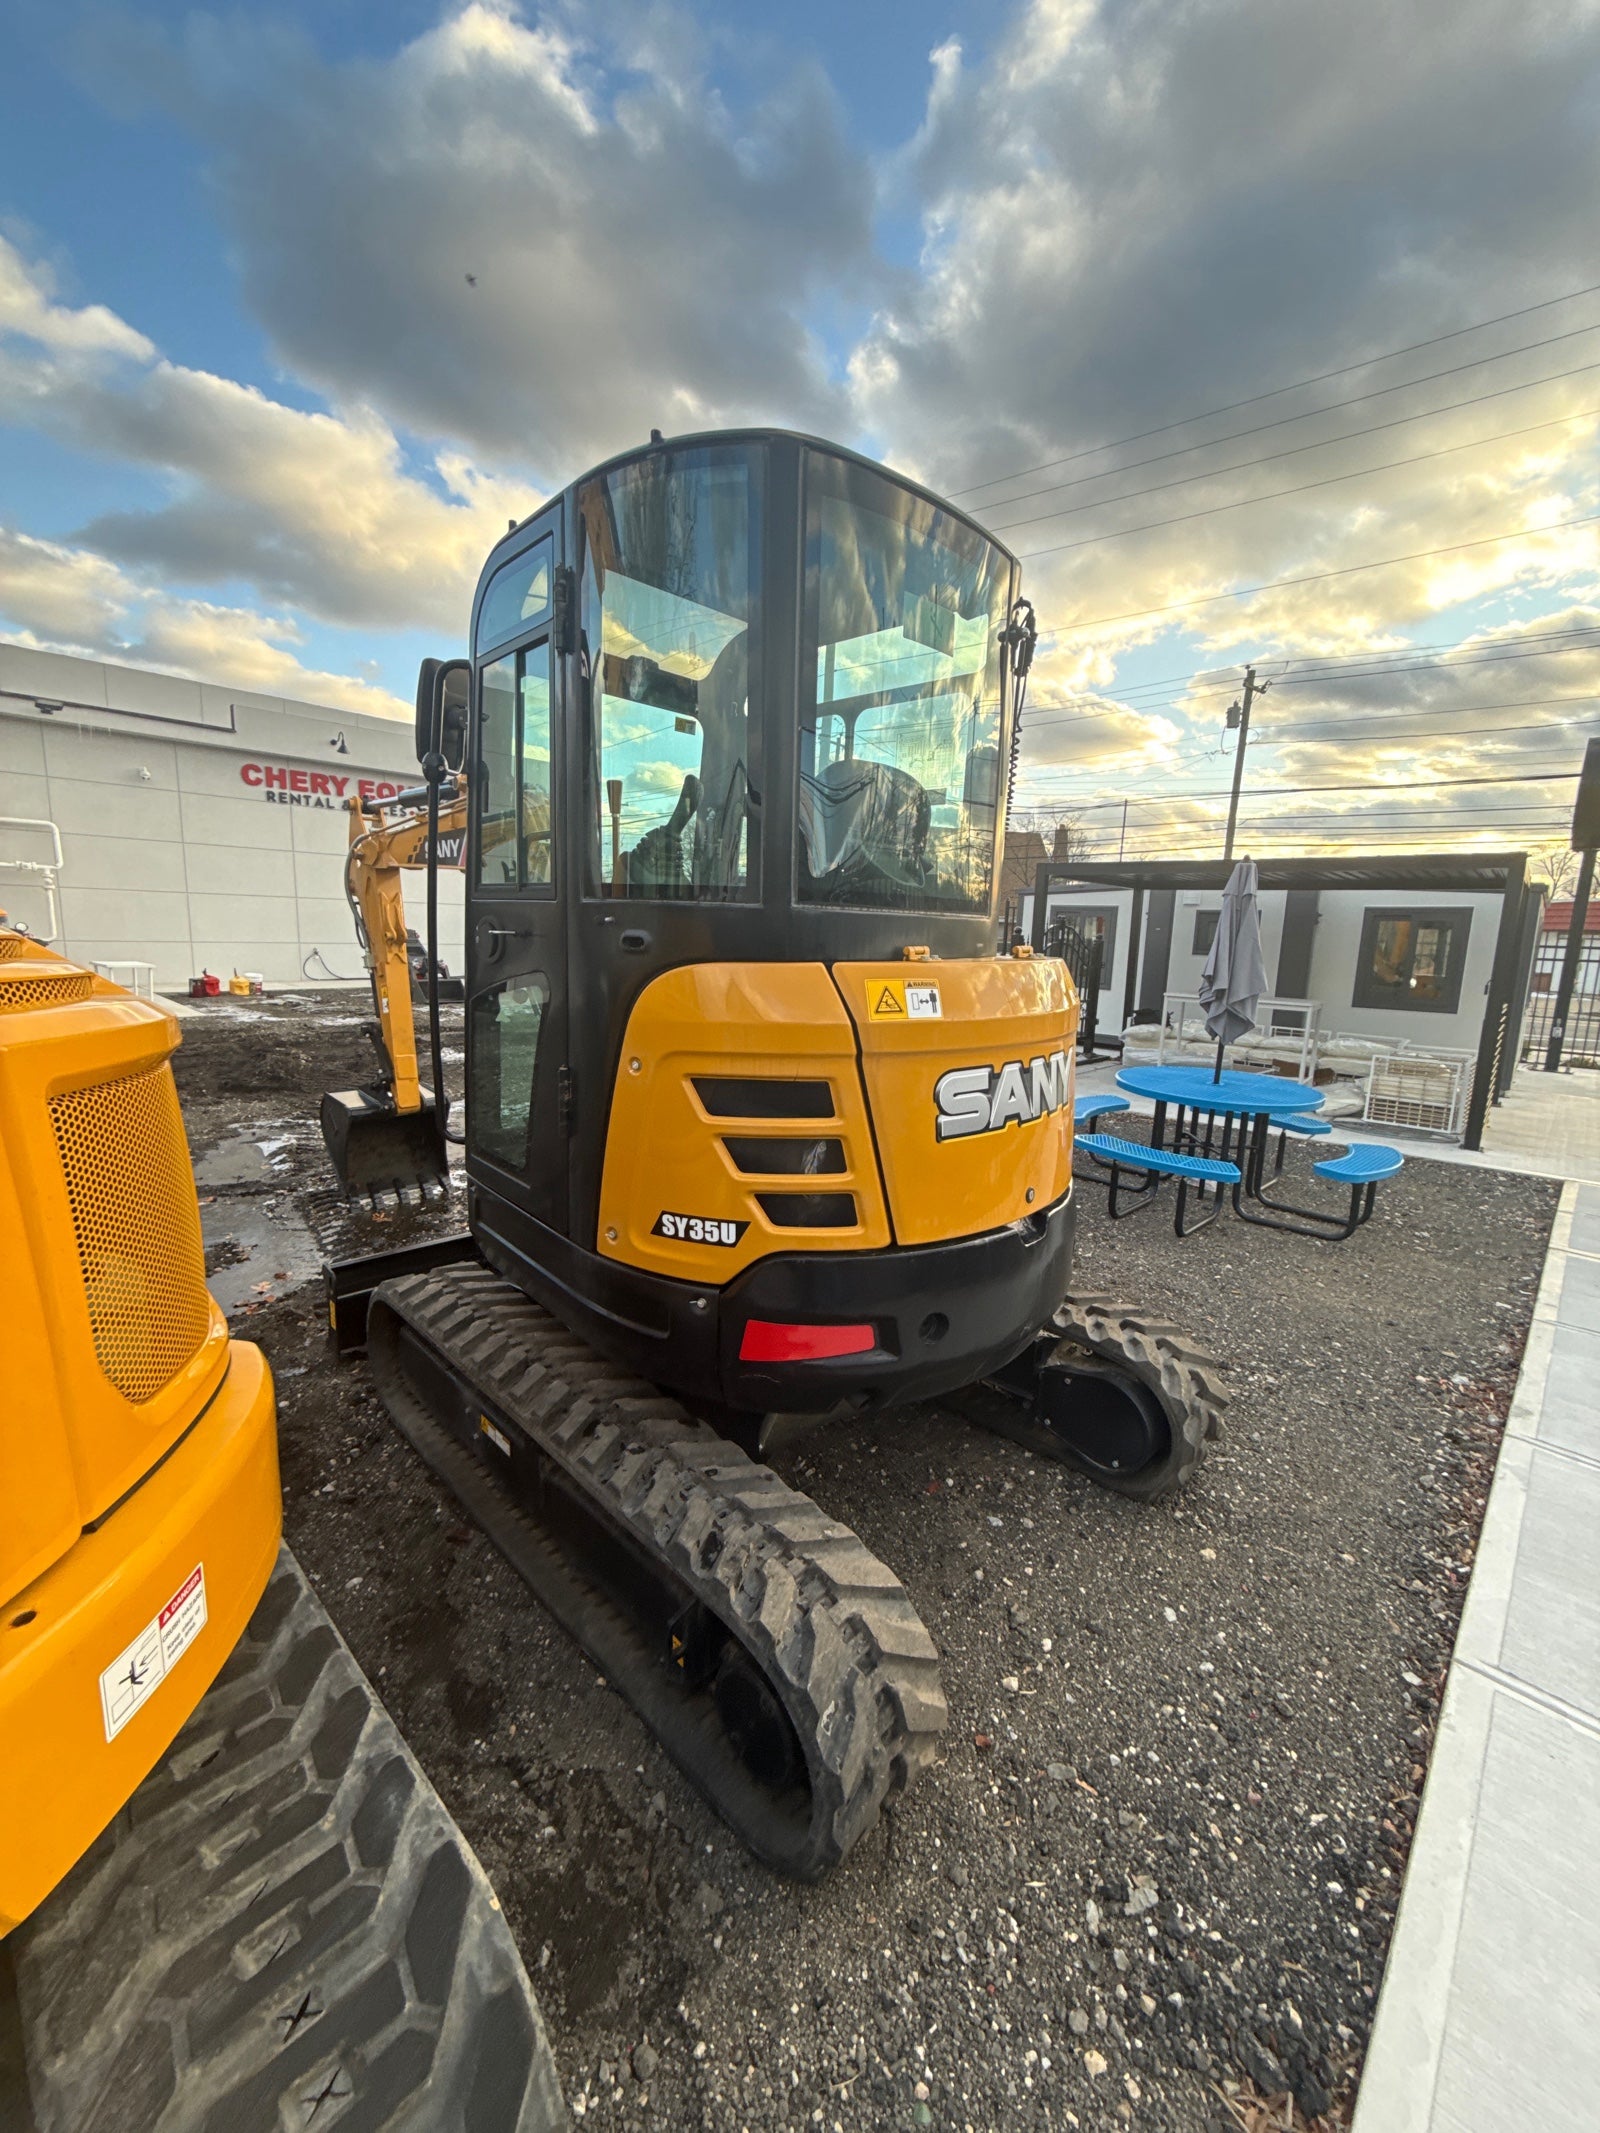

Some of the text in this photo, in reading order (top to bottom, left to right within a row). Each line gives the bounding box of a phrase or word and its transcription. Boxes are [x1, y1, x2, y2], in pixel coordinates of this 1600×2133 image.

[240, 763, 350, 797] CHERY
[265, 790, 336, 810] RENTAL
[934, 1046, 1075, 1142] SANY
[661, 1213, 737, 1244] SY35U
[170, 1573, 200, 1613] DANGER
[182, 1590, 203, 1619] HAZARD
